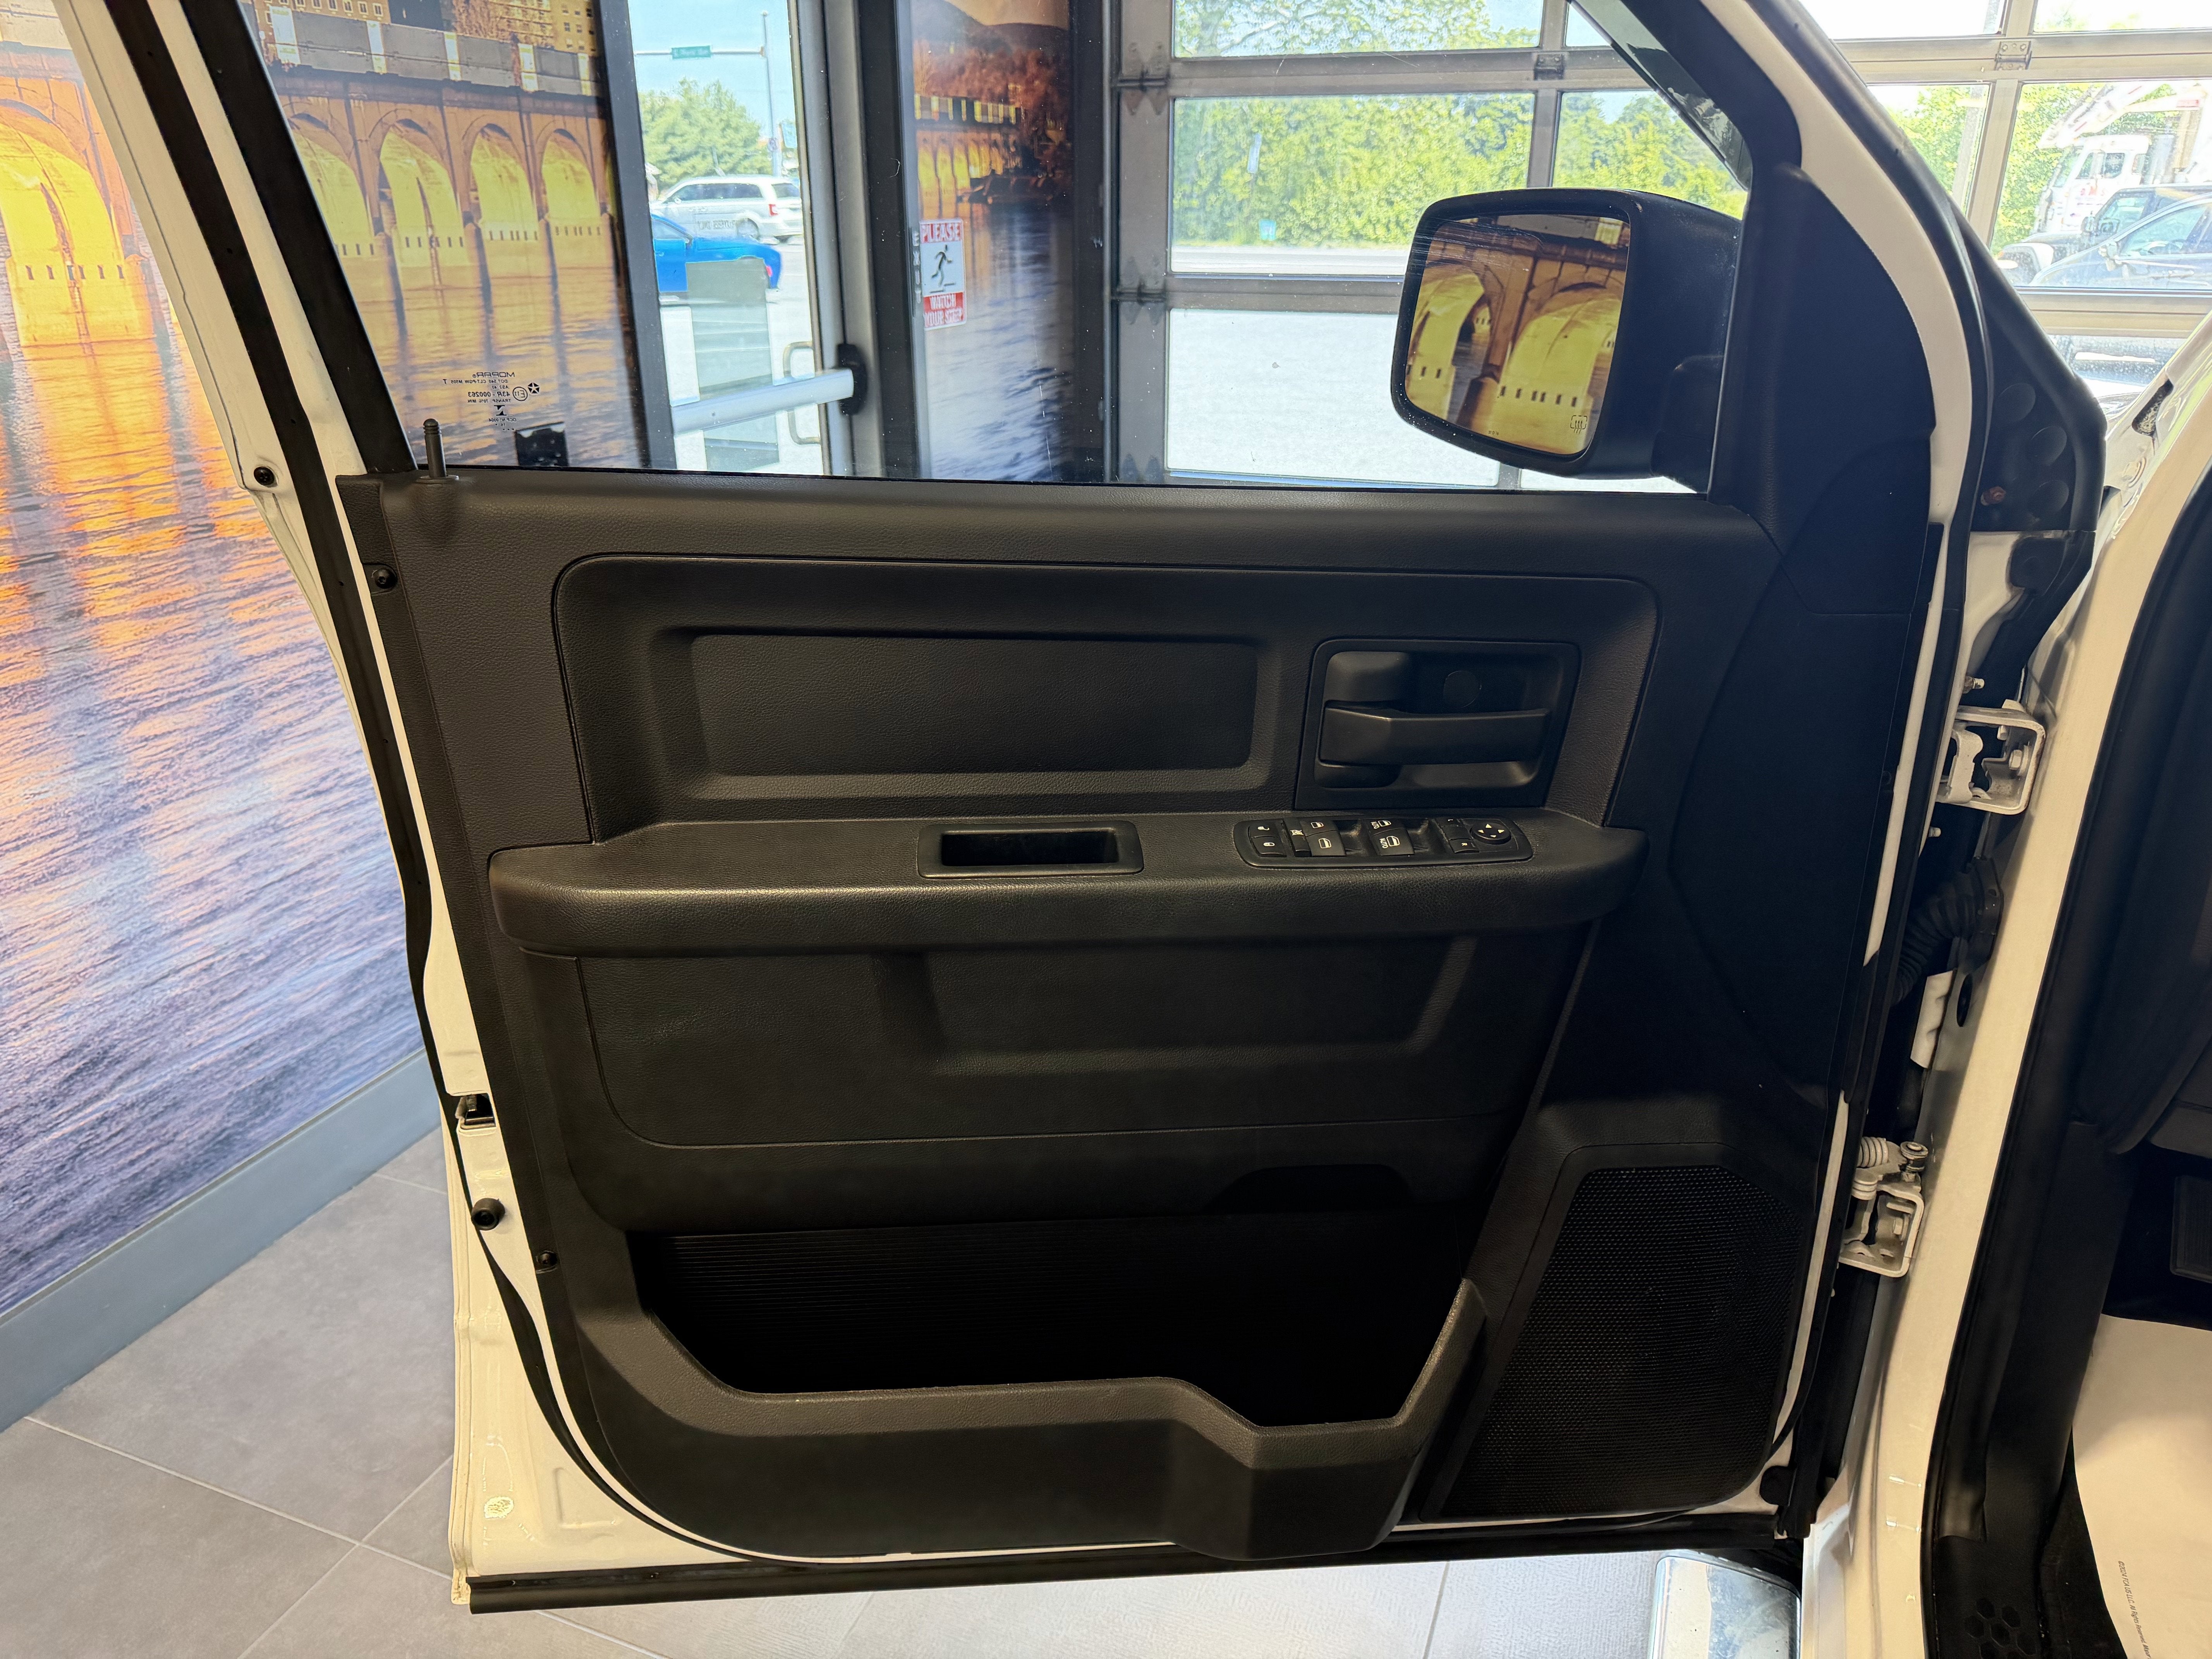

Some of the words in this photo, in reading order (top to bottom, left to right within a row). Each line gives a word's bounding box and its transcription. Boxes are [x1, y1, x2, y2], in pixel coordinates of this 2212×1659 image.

[922, 223, 960, 242] PLEASE
[930, 294, 956, 310] WATCH
[1379, 838, 1388, 848] AUTO
